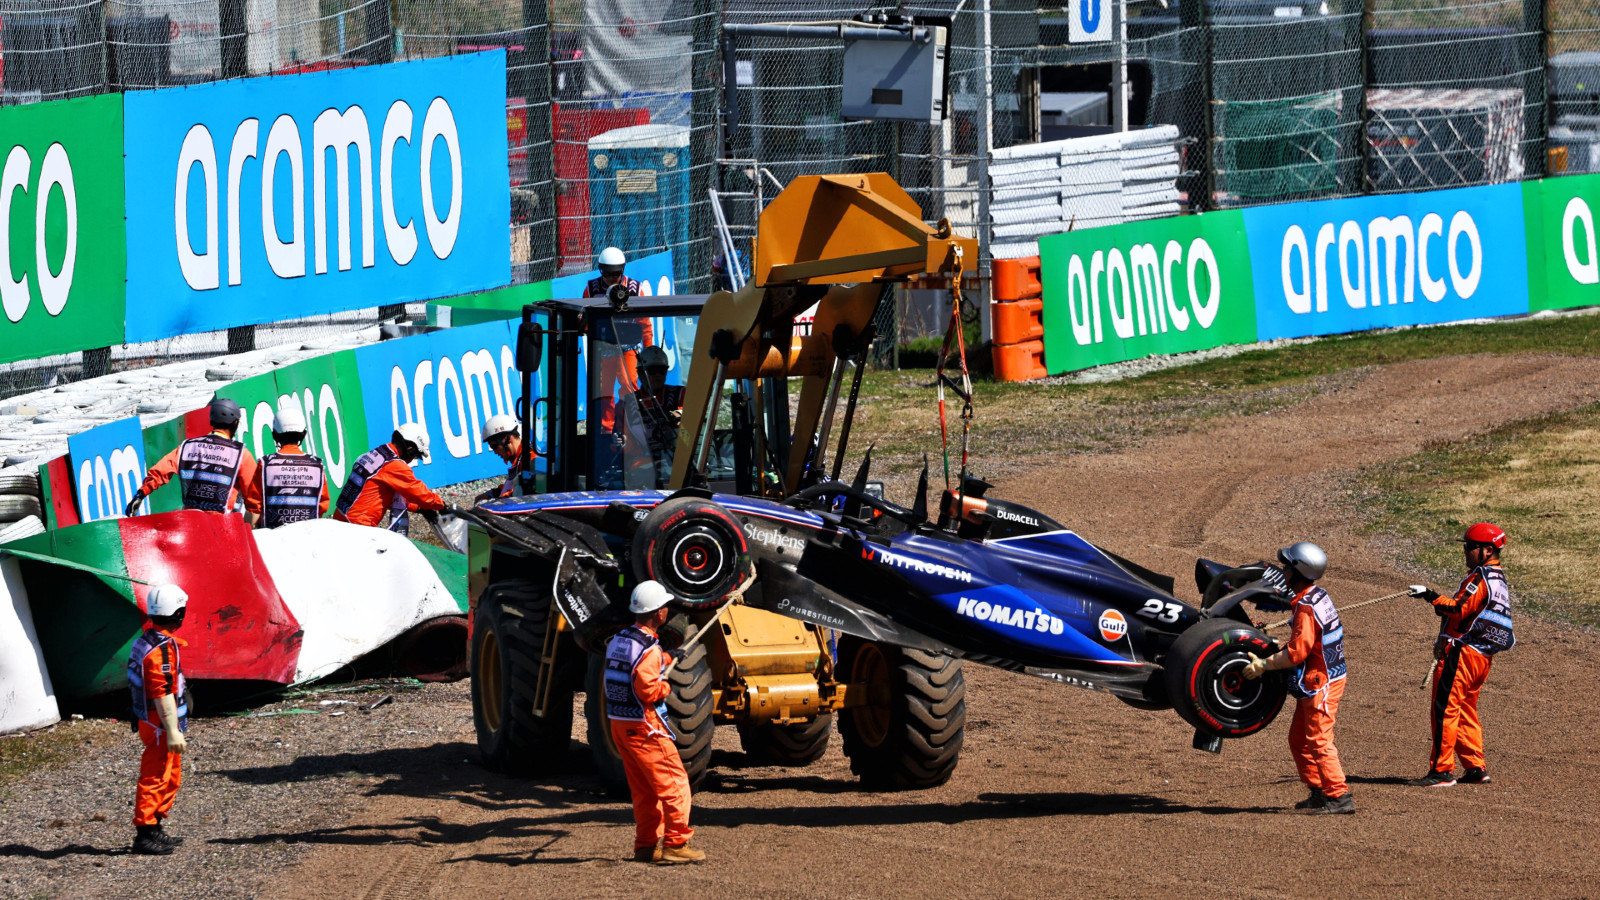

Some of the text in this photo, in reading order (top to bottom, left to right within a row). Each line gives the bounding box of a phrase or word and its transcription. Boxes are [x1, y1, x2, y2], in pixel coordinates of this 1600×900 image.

[174, 96, 463, 291] aramco
[1281, 210, 1482, 314] aramco
[1067, 237, 1220, 346] aramco
[390, 344, 522, 468] aramc
[79, 444, 151, 521] ram
[277, 508, 311, 516] COURSE
[996, 509, 1040, 527] DURACELL
[743, 522, 806, 551] Stephens
[880, 550, 972, 584] MYPROTEIN
[789, 605, 845, 627] PURESTREAM
[956, 596, 1065, 636] KOMATSU
[1100, 618, 1126, 633] Gulf
[1135, 598, 1184, 624] 23
[1481, 631, 1508, 647] ACCESS
[1485, 625, 1510, 641] COURSE
